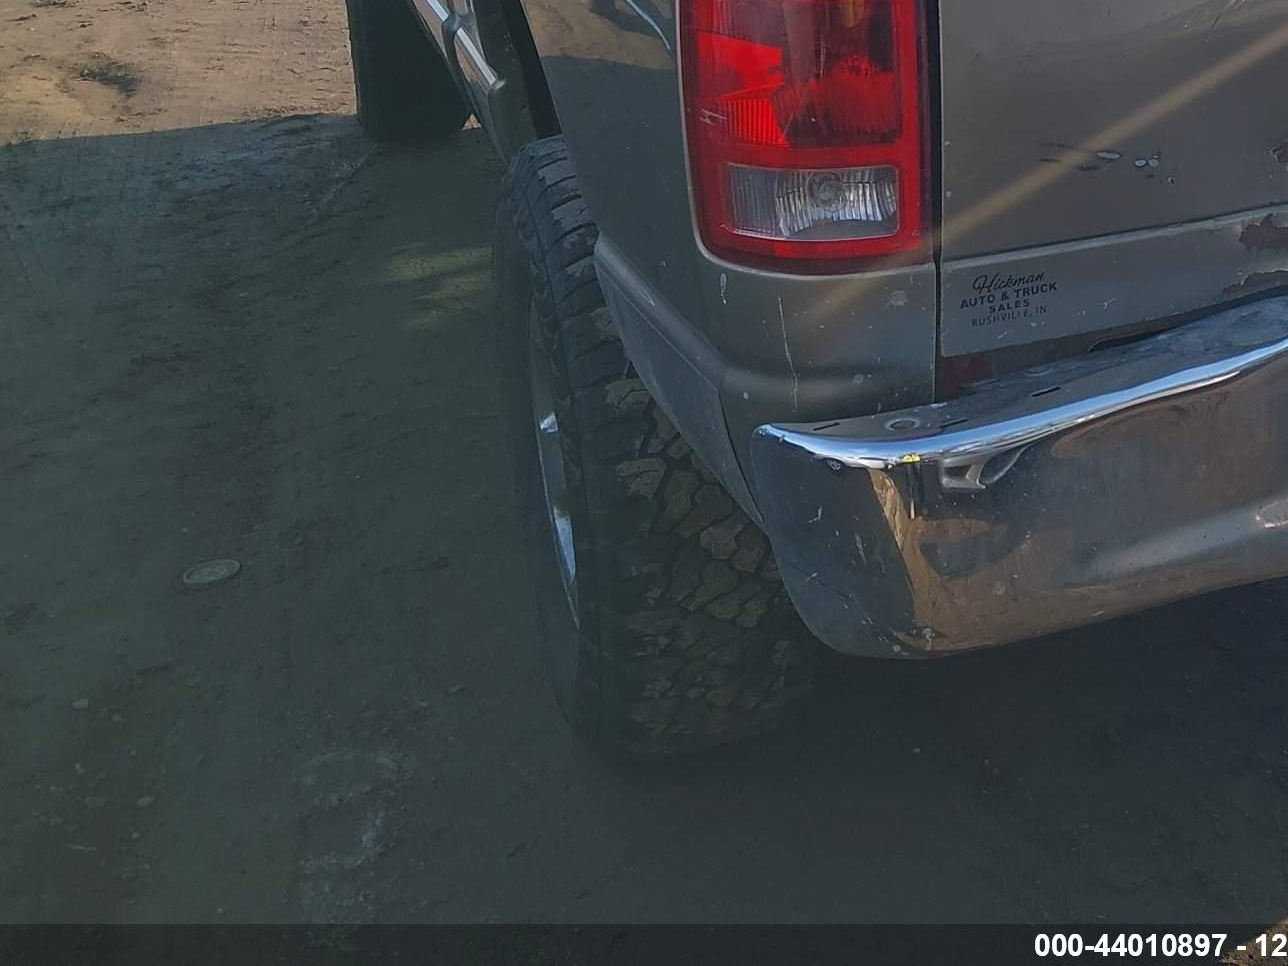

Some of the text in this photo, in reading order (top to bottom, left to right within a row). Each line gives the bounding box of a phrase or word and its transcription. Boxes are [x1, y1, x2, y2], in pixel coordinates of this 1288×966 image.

[972, 272, 1045, 294] Hickman
[960, 282, 1057, 309] AUTO & TRUCK
[989, 298, 1030, 313] SALES
[1035, 305, 1047, 314] IN
